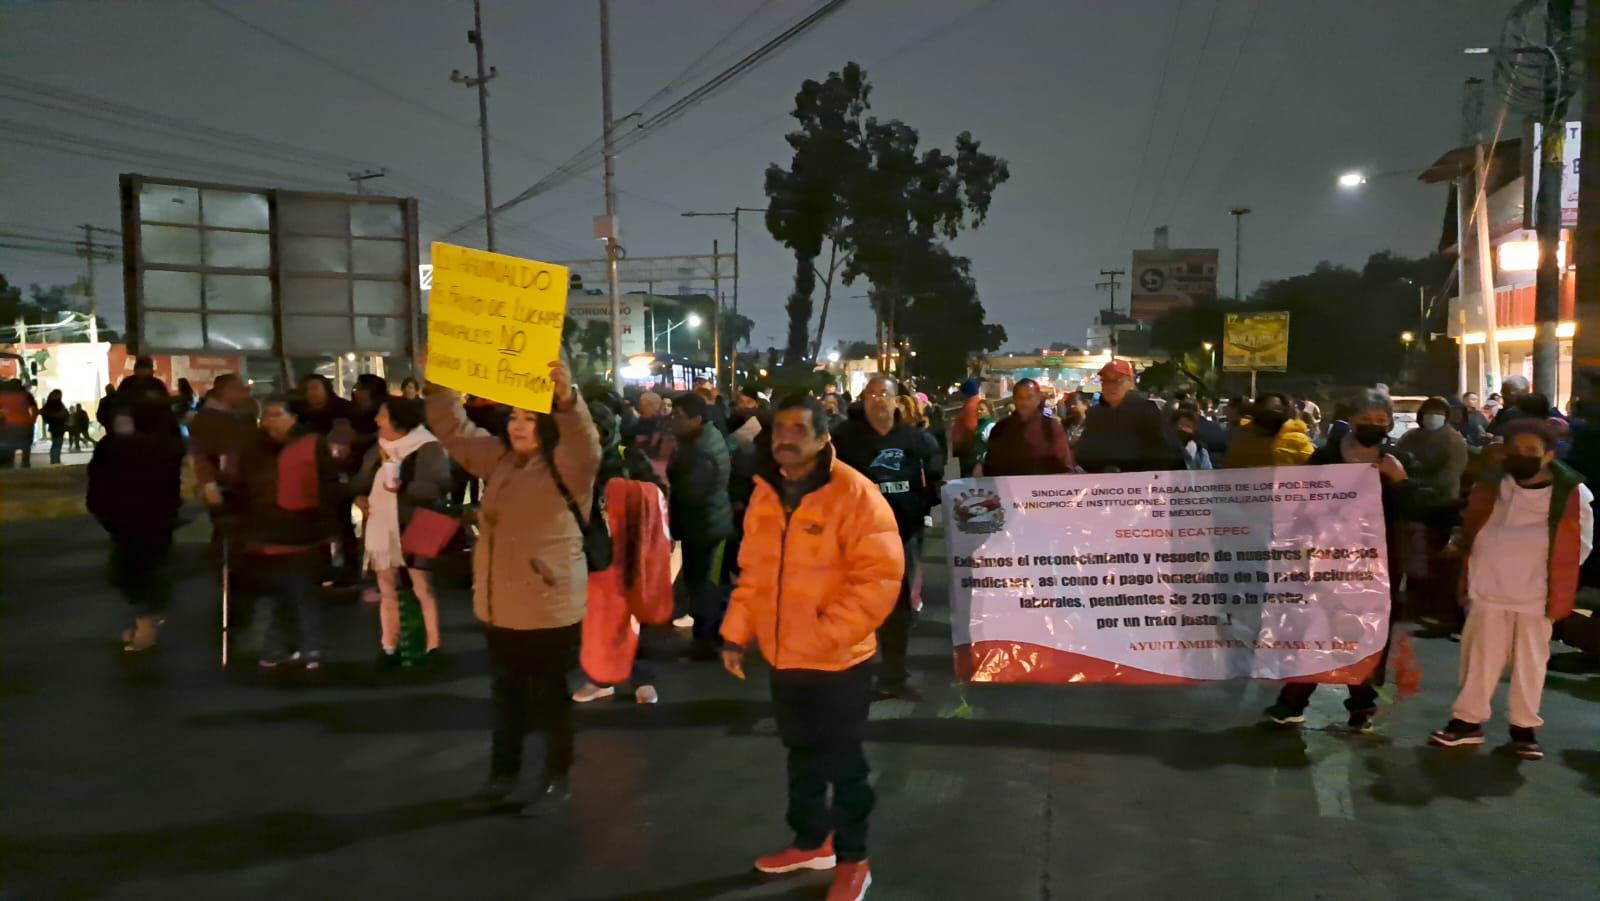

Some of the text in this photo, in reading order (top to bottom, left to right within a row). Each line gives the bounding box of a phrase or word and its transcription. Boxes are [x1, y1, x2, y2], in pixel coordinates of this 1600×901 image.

[488, 299, 506, 319] DE
[570, 306, 631, 316] CORONO
[498, 324, 527, 354] NO
[1128, 487, 1142, 495] DE
[1235, 483, 1250, 492] DE
[1253, 482, 1274, 491] LOS
[1076, 500, 1084, 508] E
[1086, 498, 1167, 508] INSTITUCIONES
[1170, 495, 1281, 506] DESCENTRALIZADAS
[1285, 494, 1307, 502] DEL
[1310, 491, 1358, 501] ESTADO
[1152, 509, 1166, 518] DE
[1178, 526, 1251, 538] ECATEPEC
[1018, 554, 1029, 567] el
[1034, 552, 1139, 566] reconocimiento
[1143, 552, 1151, 565] y
[1214, 549, 1232, 562] de
[1236, 548, 1301, 561] nuestros
[1062, 575, 1098, 587] como
[1103, 574, 1115, 586] el
[1120, 573, 1154, 586] pago
[1157, 571, 1229, 584] inmediato
[1234, 570, 1252, 583] de
[1256, 570, 1269, 583] la
[1089, 592, 1165, 608] pendientes
[1170, 592, 1187, 605] de
[1192, 592, 1227, 605] 2019
[1231, 594, 1242, 605] a
[1245, 592, 1258, 605] la
[1097, 616, 1119, 630] por
[1124, 616, 1140, 628] un
[1145, 614, 1177, 627] trato
[1181, 613, 1218, 627] justo
